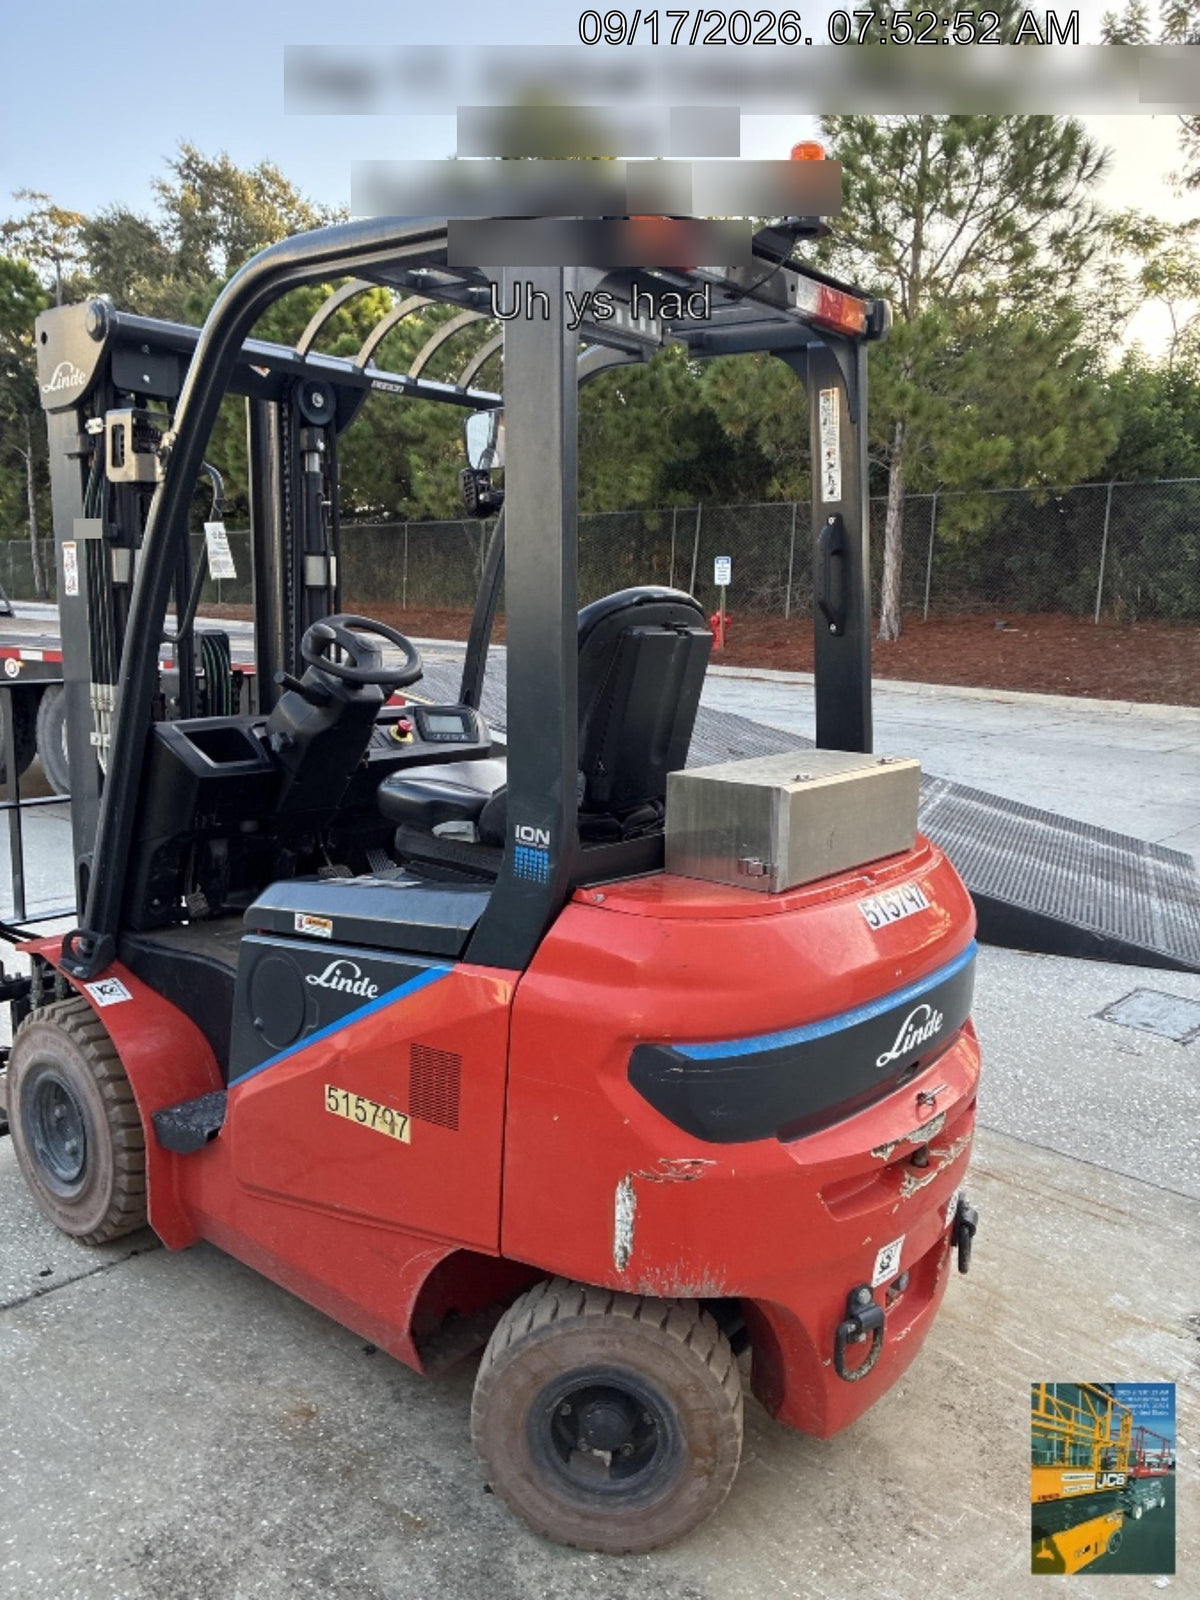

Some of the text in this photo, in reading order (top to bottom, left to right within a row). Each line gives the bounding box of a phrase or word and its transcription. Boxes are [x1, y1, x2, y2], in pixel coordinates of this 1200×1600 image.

[41, 361, 87, 393] Linde
[514, 824, 550, 845] ION
[857, 881, 926, 927] 515797
[305, 959, 379, 999] Linde
[876, 1003, 943, 1067] Linde
[326, 1085, 409, 1139] 515797
